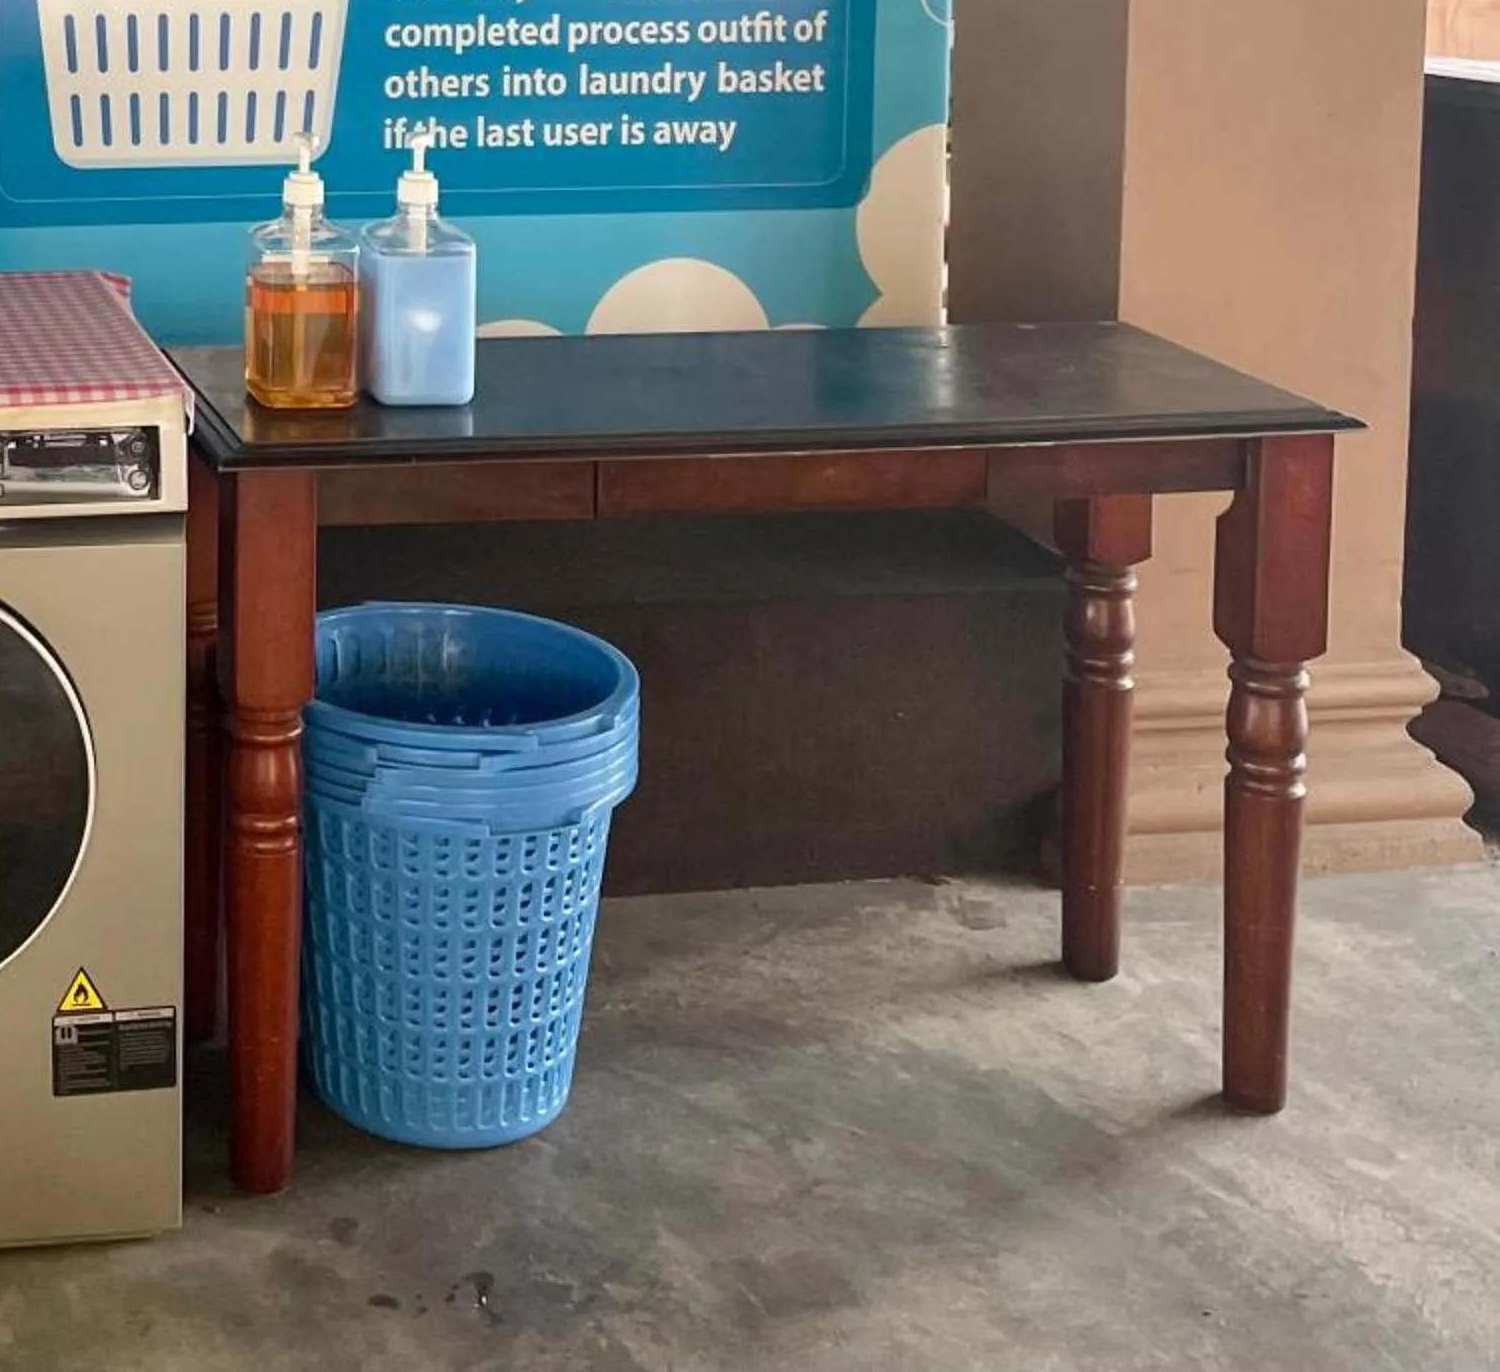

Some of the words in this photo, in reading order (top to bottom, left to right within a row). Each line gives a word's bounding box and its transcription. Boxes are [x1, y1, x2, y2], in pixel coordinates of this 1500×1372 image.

[385, 13, 561, 55] completed
[567, 20, 691, 53] process
[697, 10, 787, 44] outfit
[793, 9, 828, 42] of
[384, 65, 490, 99] others
[503, 65, 567, 97] into
[579, 61, 707, 103] laundry
[717, 60, 825, 93] basket
[384, 116, 408, 149] if
[477, 115, 535, 147] last
[543, 122, 613, 146] user
[621, 113, 645, 145] is
[653, 120, 737, 152] away
